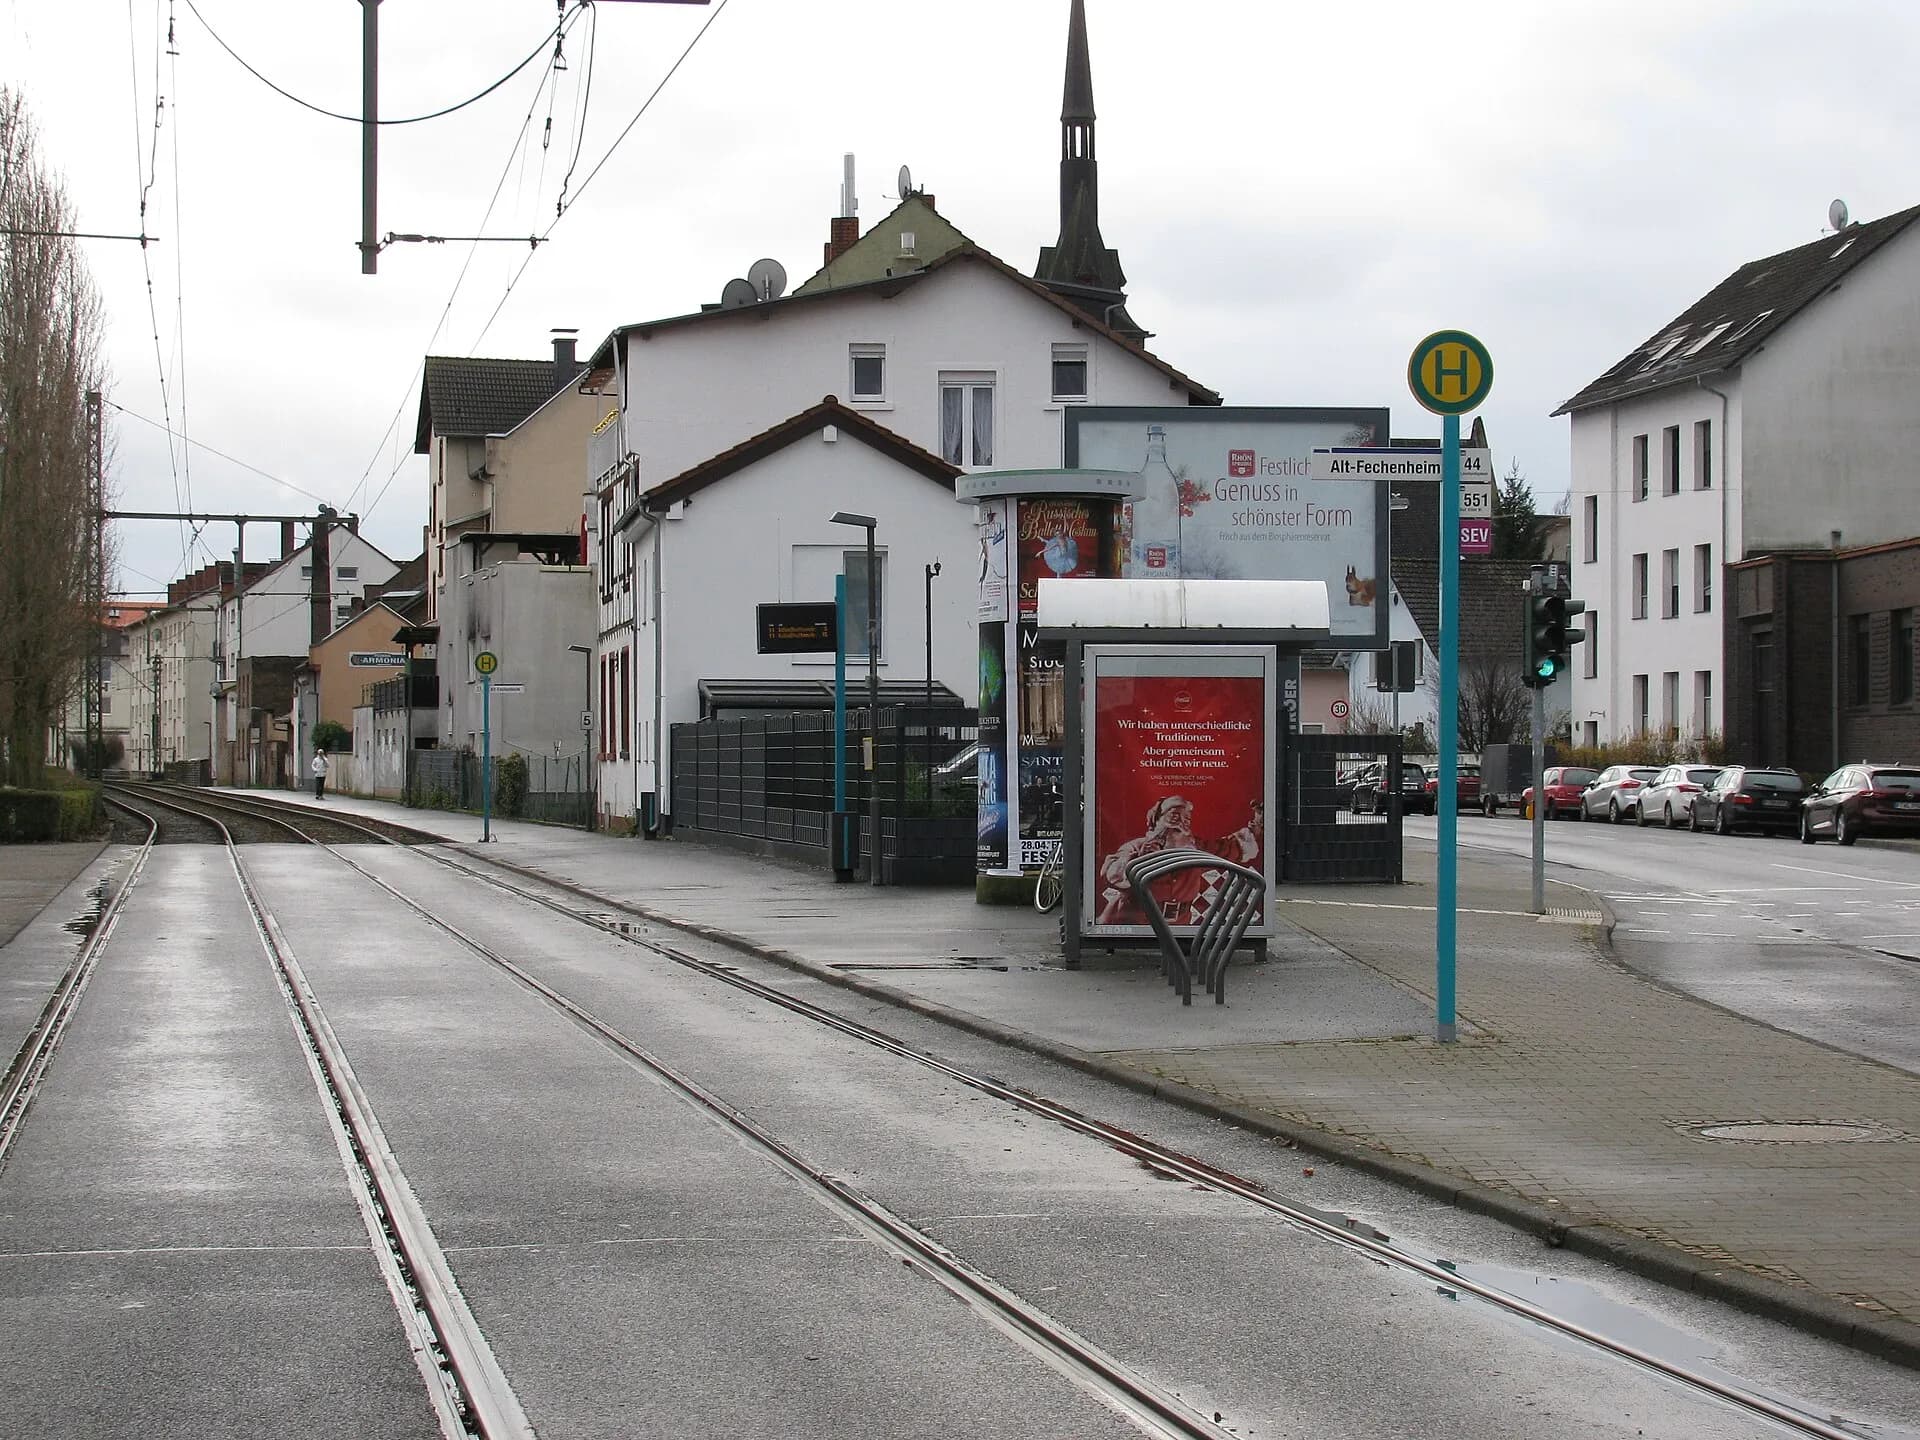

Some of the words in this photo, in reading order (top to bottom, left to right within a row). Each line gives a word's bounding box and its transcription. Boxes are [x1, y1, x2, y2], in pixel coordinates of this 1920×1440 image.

[1435, 350, 1467, 395] H
[1330, 460, 1441, 474] Alt-Fechenheim
[1464, 457, 1481, 470] 44
[1214, 478, 1281, 502] Genuss
[1285, 483, 1298, 501] in
[1463, 493, 1488, 507] 551
[1232, 508, 1301, 527] schönster
[1306, 503, 1352, 527] Form
[1460, 527, 1489, 542] SEV
[481, 656, 491, 669] H
[1335, 704, 1346, 714] 30
[583, 715, 591, 726] 5
[1117, 720, 1136, 730] Wir
[1138, 720, 1169, 730] haben
[1171, 719, 1251, 730] unterschiedliche
[1154, 732, 1215, 742] Traditionen.
[1142, 746, 1166, 756] Aber
[1167, 747, 1225, 758] gemeinsam
[1139, 759, 1183, 768] schaffen
[1184, 760, 1200, 768] wir
[1202, 760, 1229, 768] neue.
